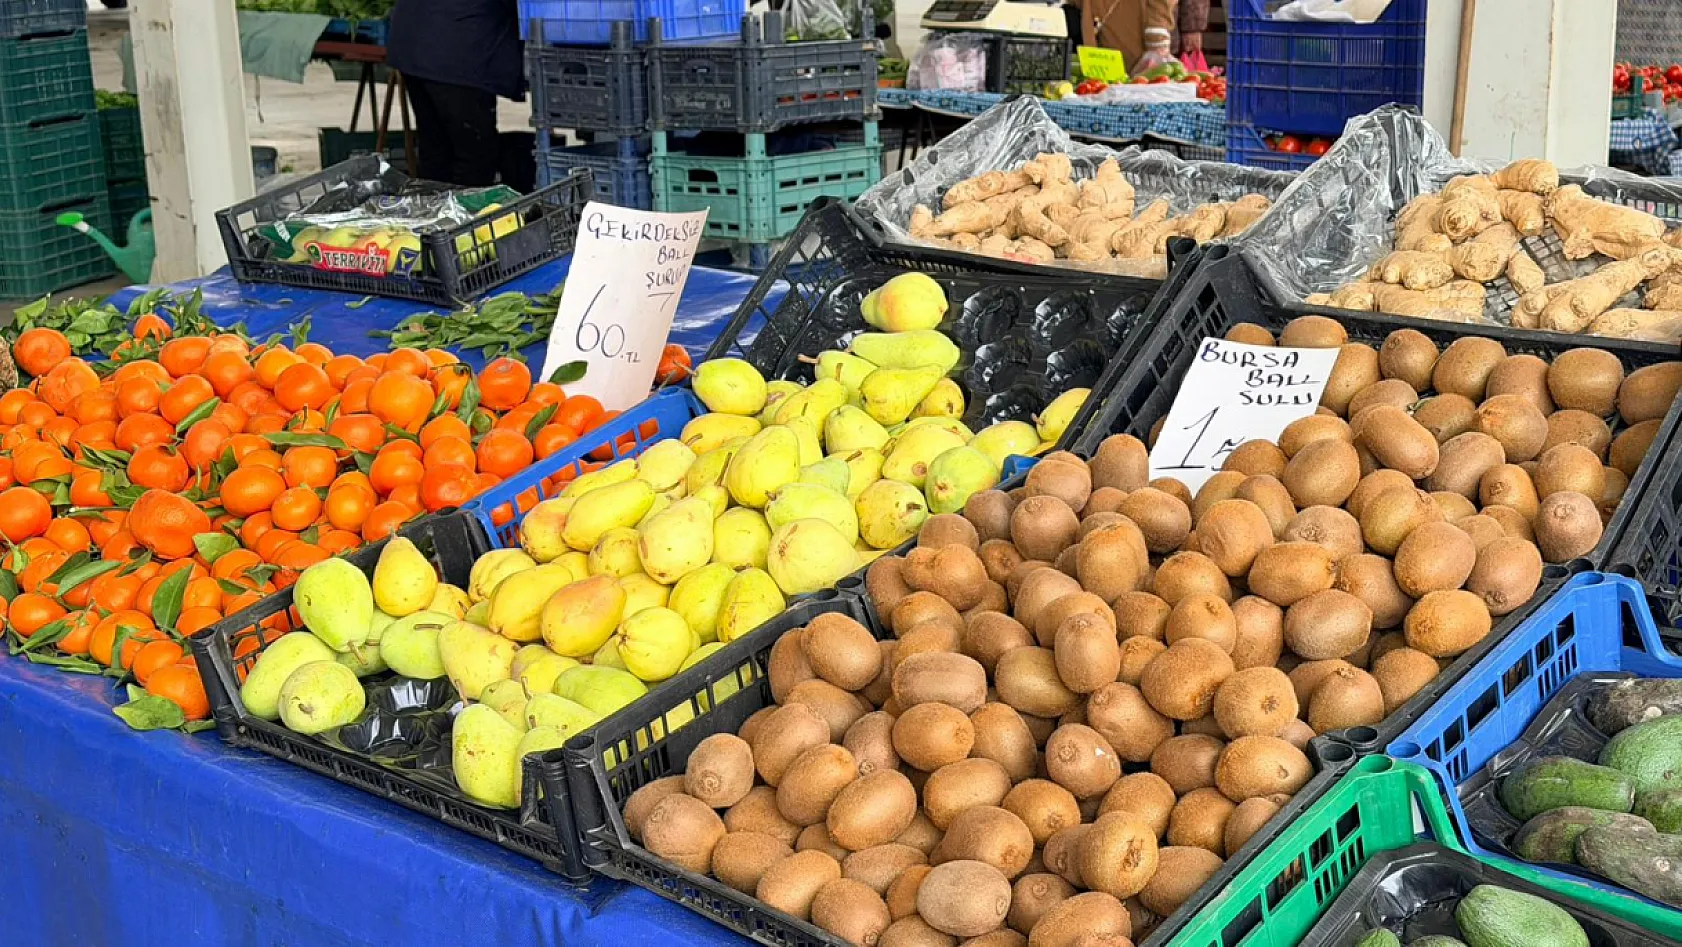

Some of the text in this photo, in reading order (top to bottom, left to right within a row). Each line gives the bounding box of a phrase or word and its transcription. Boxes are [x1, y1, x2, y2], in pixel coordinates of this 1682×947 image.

[657, 245, 690, 265] BALL
[1200, 341, 1299, 368] BURSA
[1245, 369, 1321, 388] BALL
[1239, 390, 1313, 406] SULU
